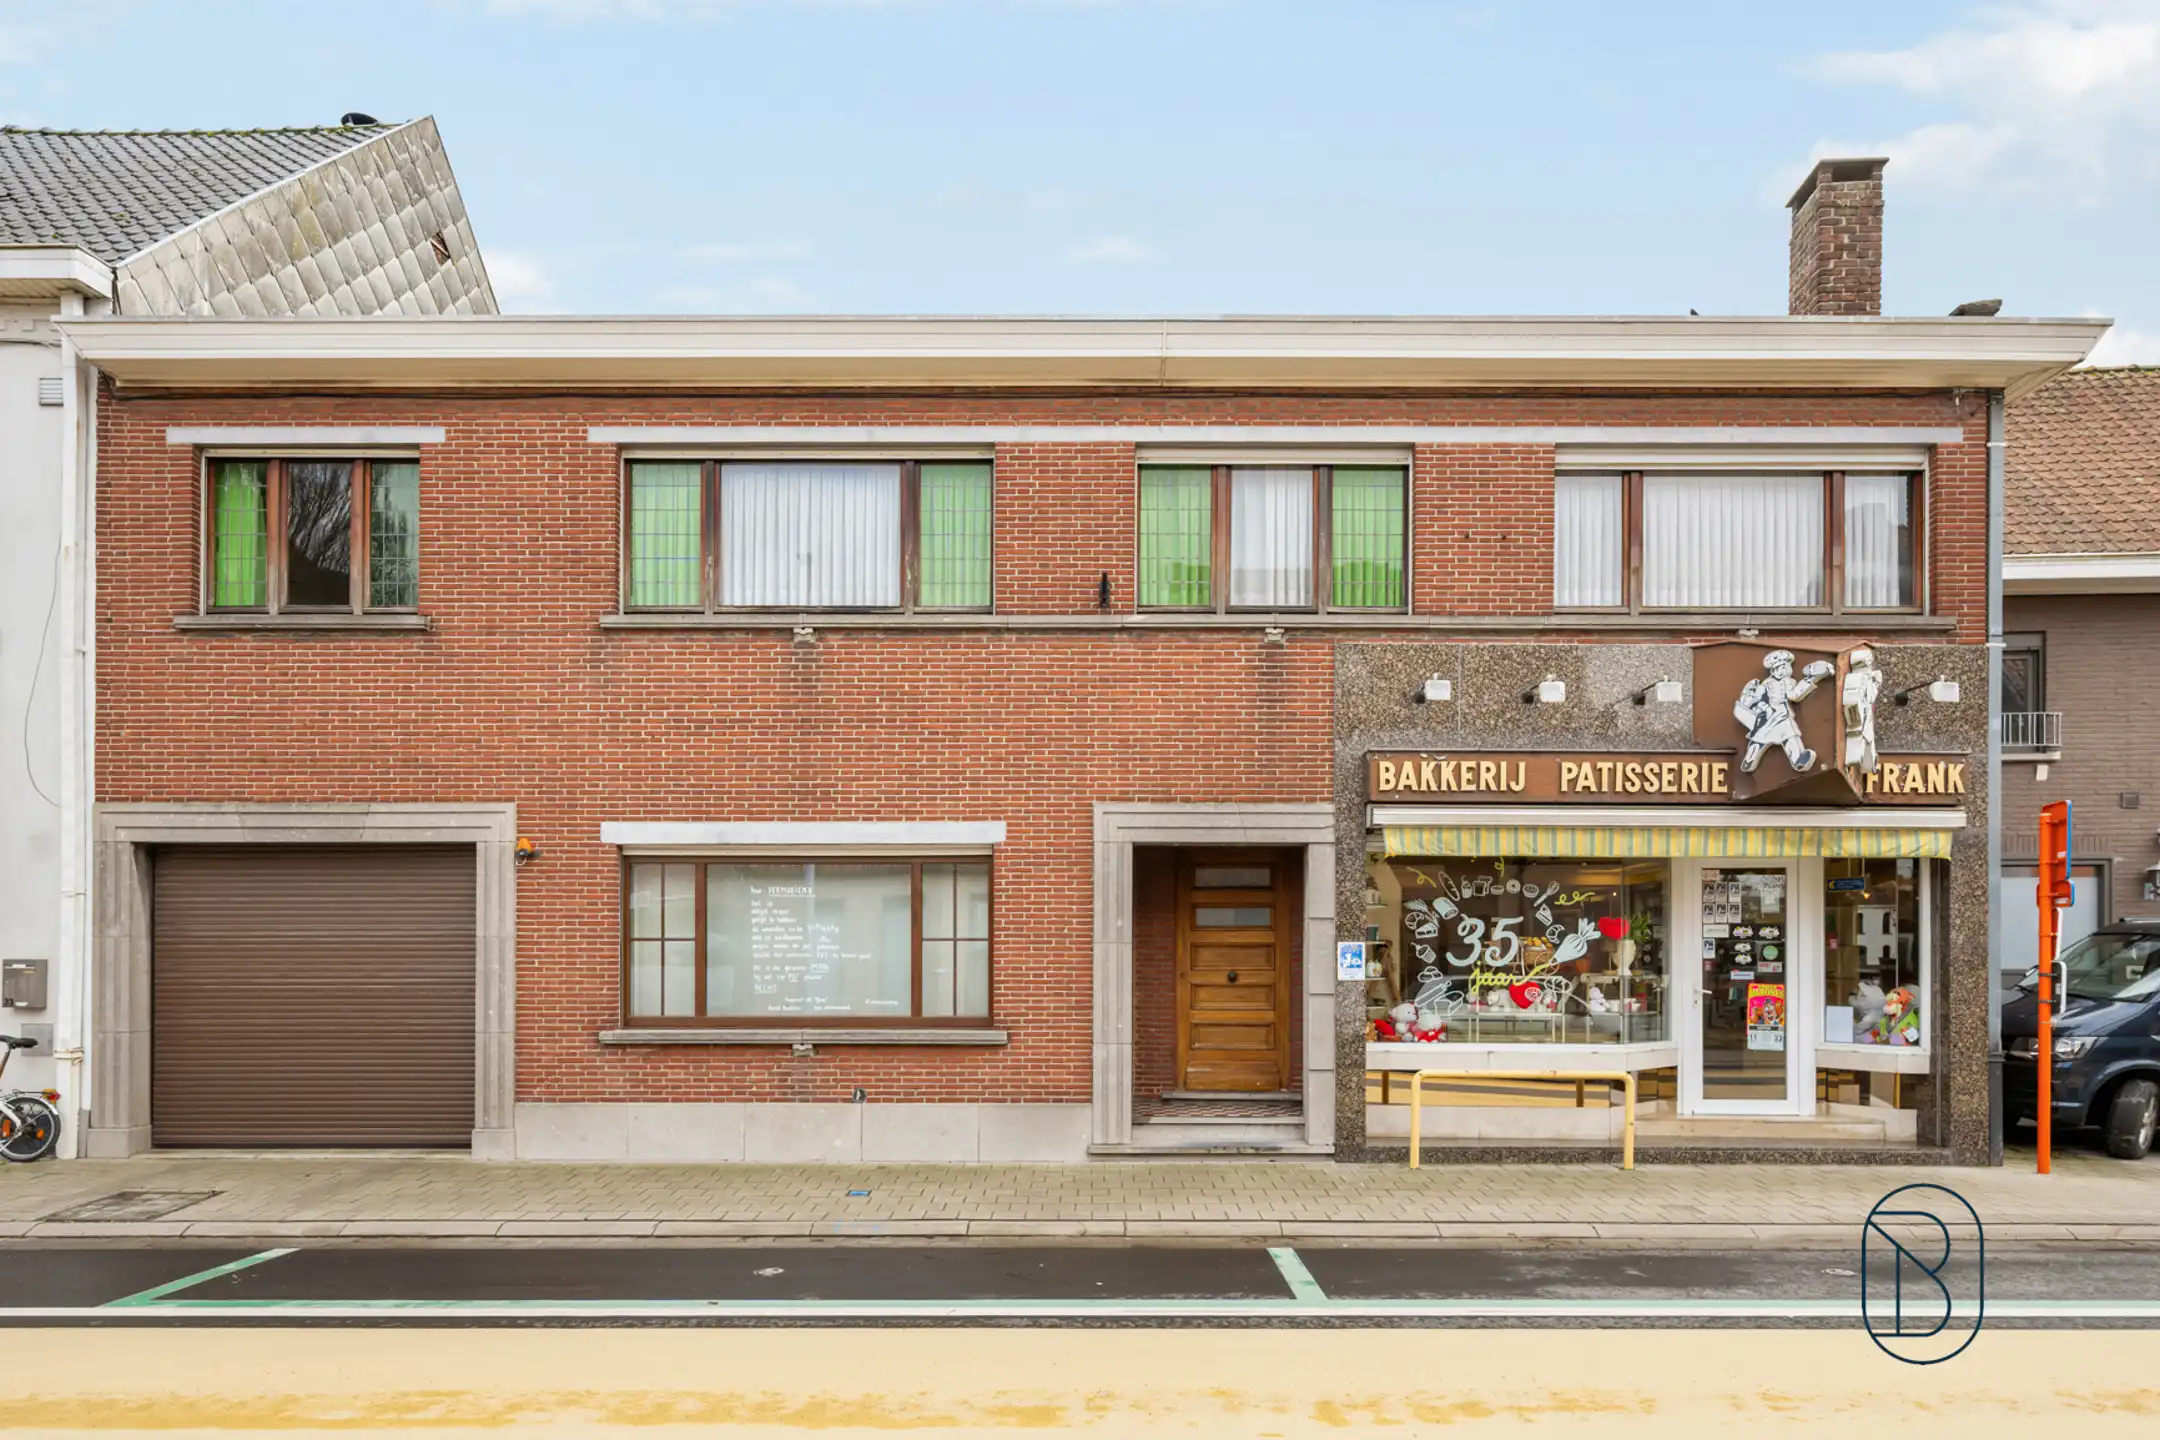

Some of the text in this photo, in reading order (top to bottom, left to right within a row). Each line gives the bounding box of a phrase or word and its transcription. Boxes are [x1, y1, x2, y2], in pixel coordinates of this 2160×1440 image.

[1378, 760, 1965, 794] BAKKERIJ PATISSERIE FRANK
[1446, 913, 1524, 967] 35
[1469, 961, 1524, 994] jaar
